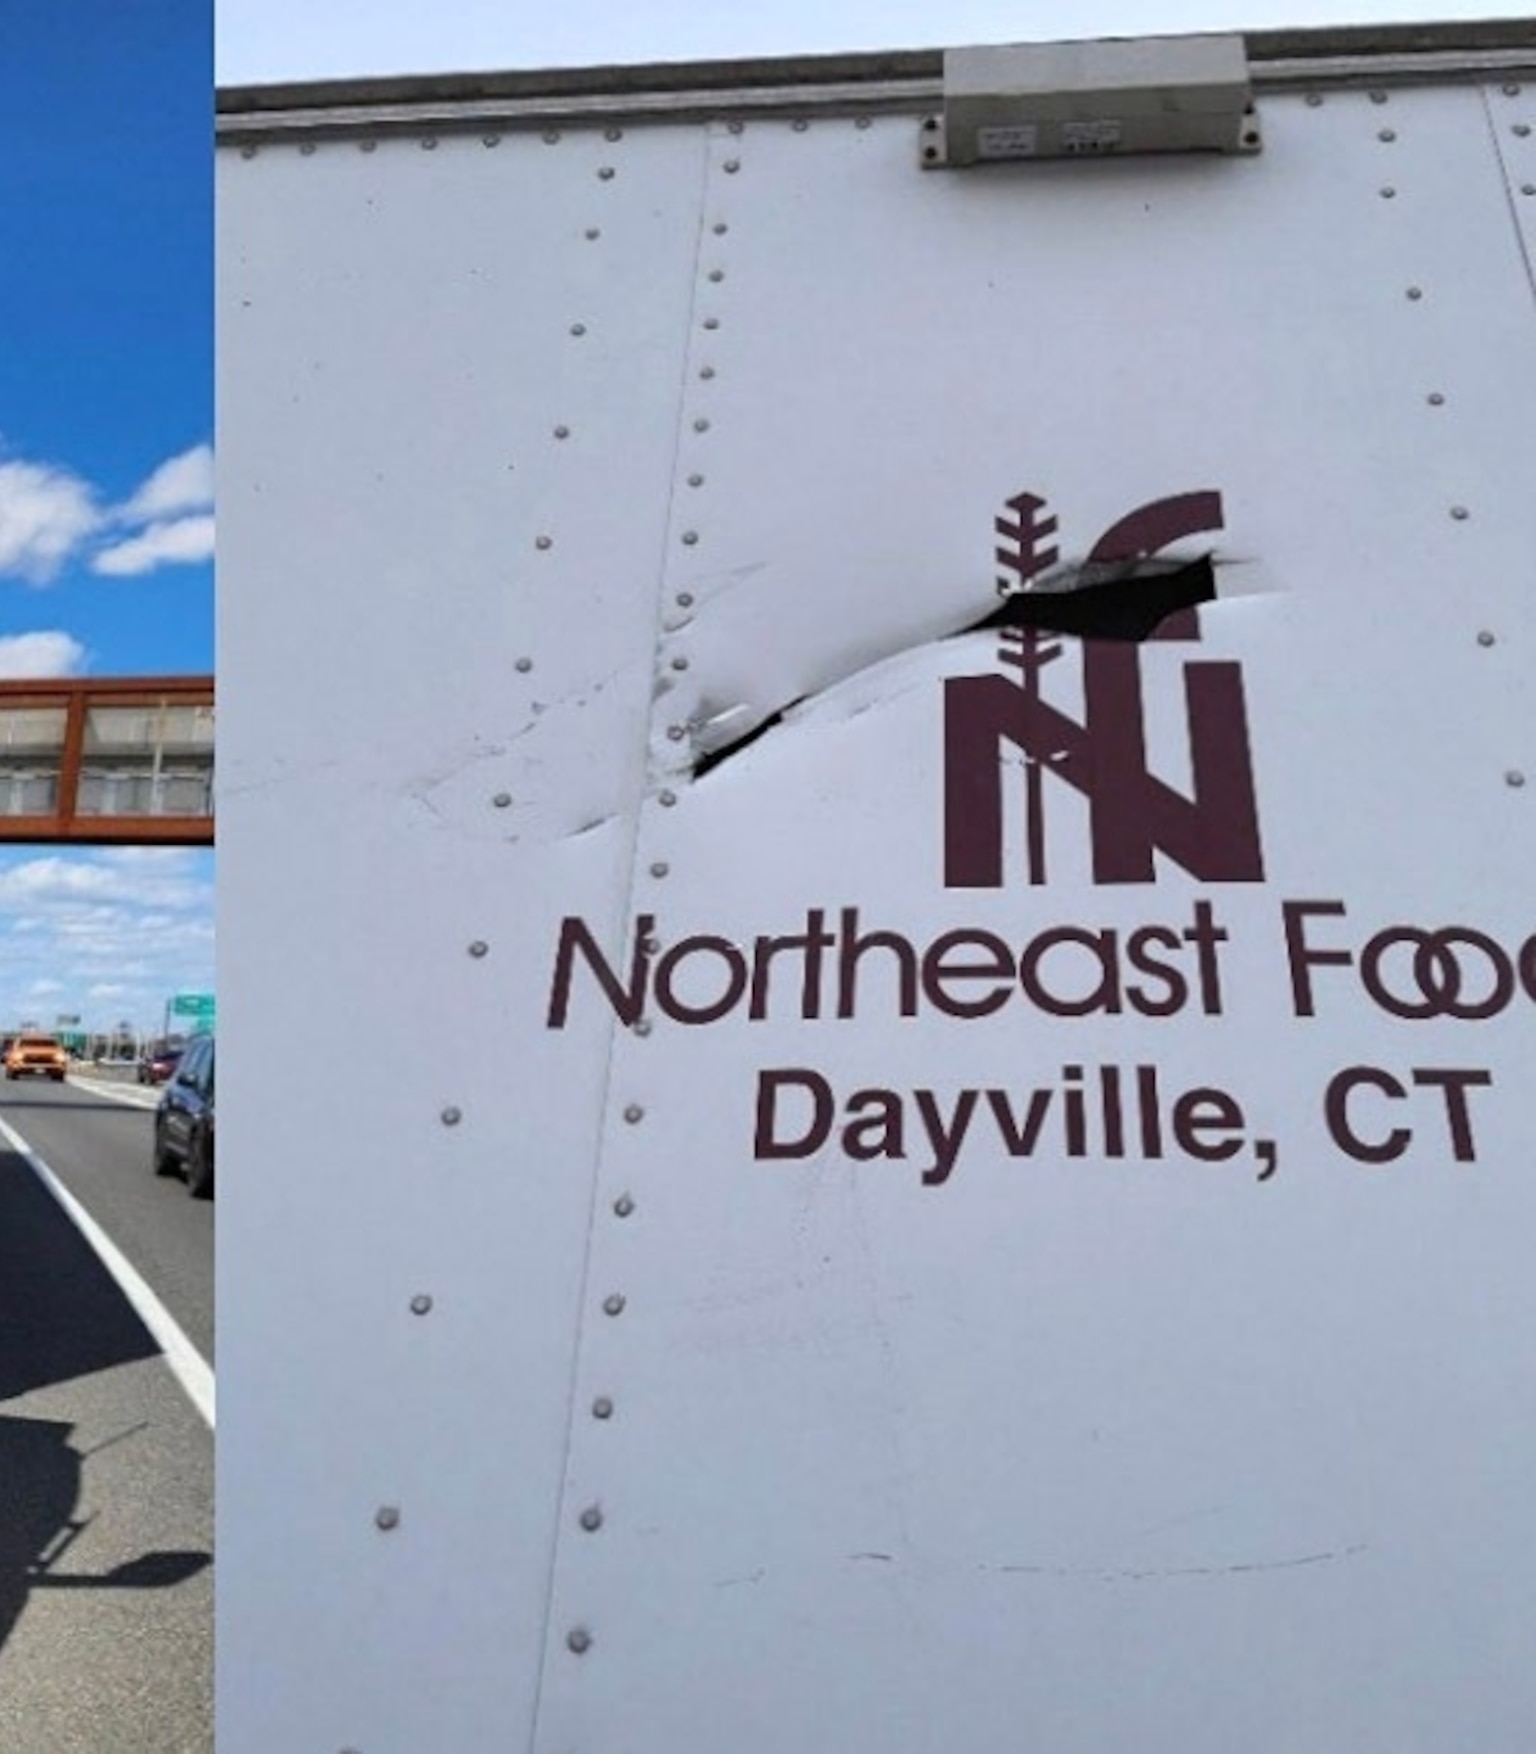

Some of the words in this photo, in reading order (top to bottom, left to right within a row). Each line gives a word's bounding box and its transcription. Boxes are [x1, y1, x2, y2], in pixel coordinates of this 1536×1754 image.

[545, 900, 1230, 1036] Northeast
[1281, 901, 1536, 1020] Foo
[753, 1064, 1277, 1187] Dayville,
[1324, 1065, 1493, 1164] CT
